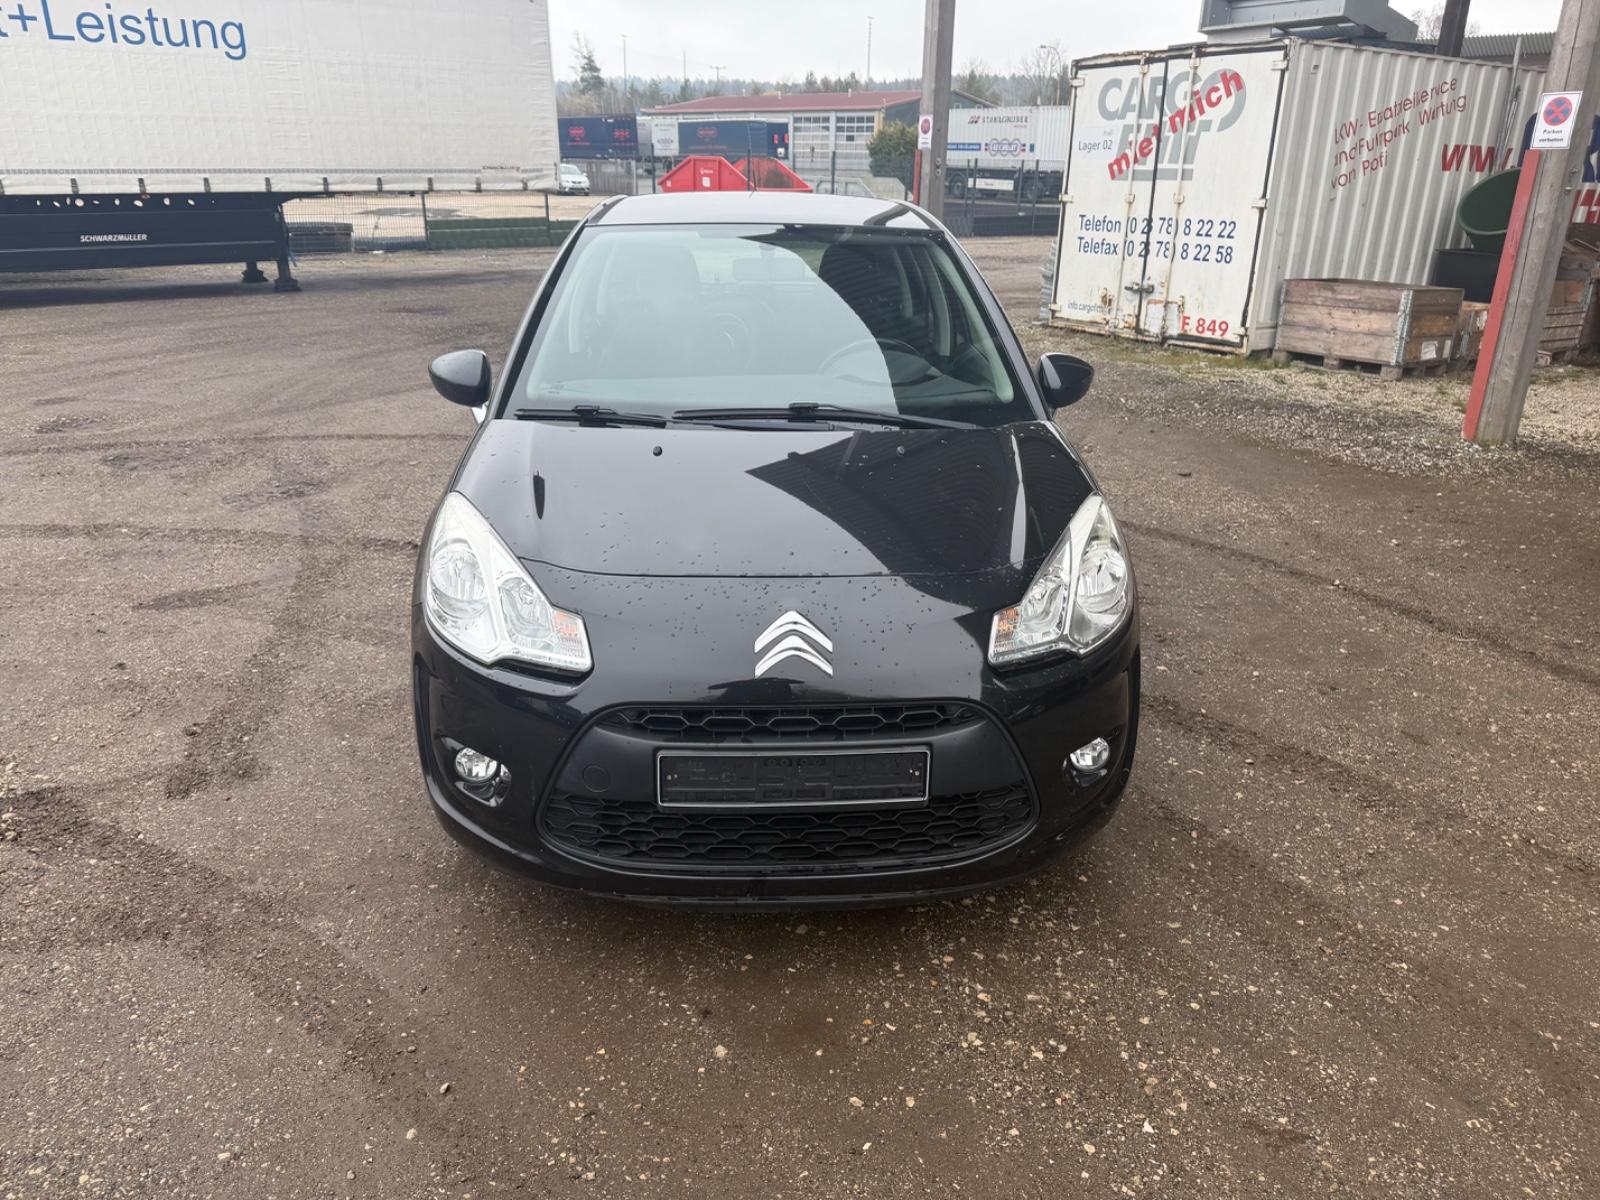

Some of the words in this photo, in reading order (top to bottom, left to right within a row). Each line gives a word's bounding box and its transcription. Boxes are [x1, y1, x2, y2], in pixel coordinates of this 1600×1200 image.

[0, 0, 246, 60] +Leistung
[1168, 70, 1243, 135] mich
[1078, 140, 1101, 153] Lager
[1102, 139, 1113, 149] 02
[1079, 214, 1121, 233] Telefon
[1125, 217, 1137, 238] (0
[1183, 218, 1192, 236] 8
[1195, 219, 1214, 238] 22
[1217, 220, 1237, 239] 22
[1077, 236, 1119, 256] Telefax
[1180, 243, 1190, 260] 8
[1193, 243, 1211, 262] 22
[1215, 245, 1233, 264] 58
[1196, 317, 1229, 337] 849
